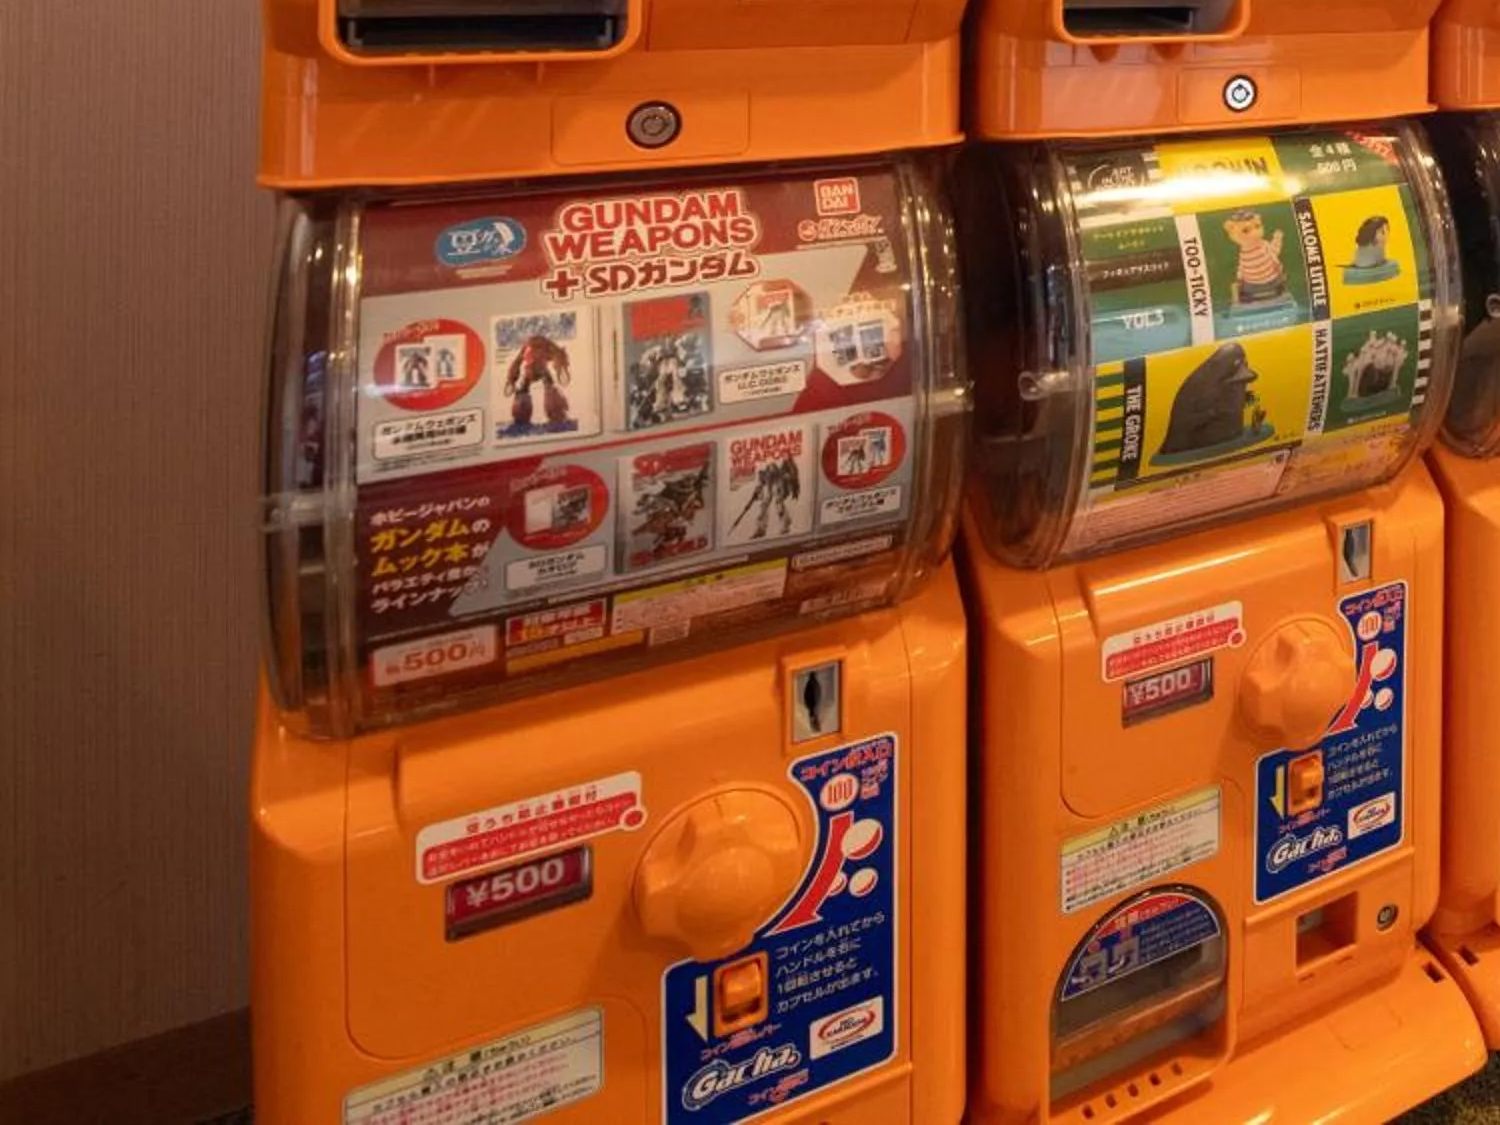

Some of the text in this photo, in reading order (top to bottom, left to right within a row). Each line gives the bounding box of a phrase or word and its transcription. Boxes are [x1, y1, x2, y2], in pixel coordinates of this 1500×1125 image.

[562, 192, 738, 233] GUNDAM
[548, 217, 755, 263] WEAPONS
[1298, 210, 1321, 266] SALOME
[1183, 236, 1209, 318] TOO-TICKY
[730, 428, 803, 456] GUNDAM
[1121, 383, 1143, 463] THE GROKE
[370, 496, 491, 526] ホビージャパンの
[370, 518, 492, 554] ガンダムの
[1129, 669, 1191, 705] ¥500
[465, 858, 565, 908] ¥500
